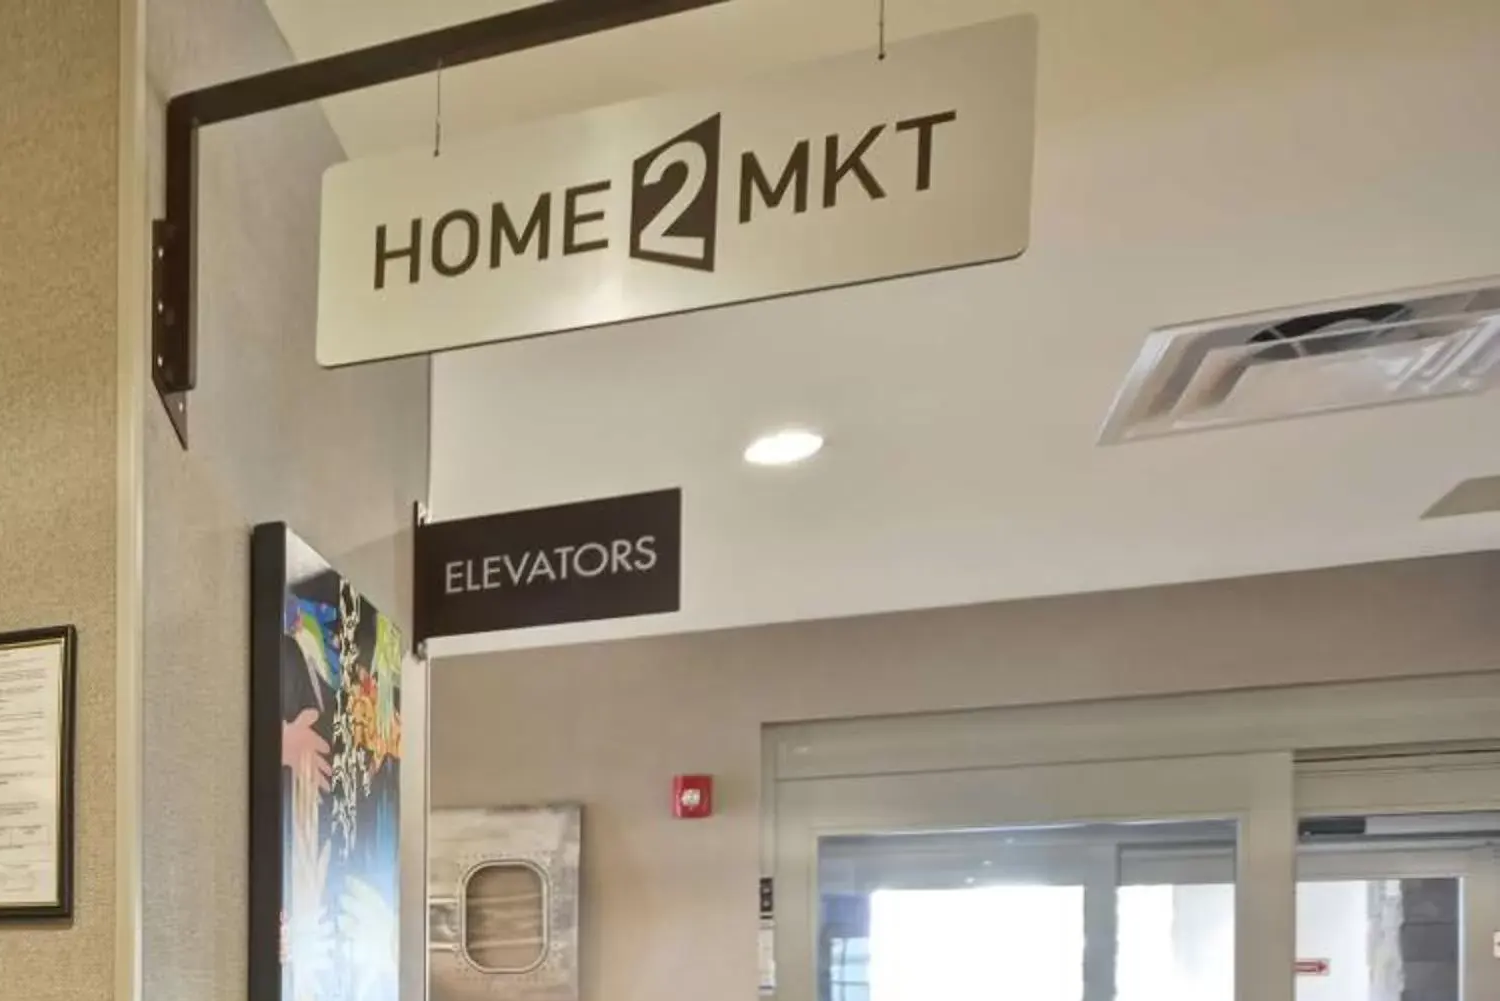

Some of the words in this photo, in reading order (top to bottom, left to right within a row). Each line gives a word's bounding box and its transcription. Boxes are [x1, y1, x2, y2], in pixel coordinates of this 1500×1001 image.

[373, 179, 612, 290] HOME
[738, 110, 957, 225] MKT
[445, 536, 657, 594] ELEVATORS
